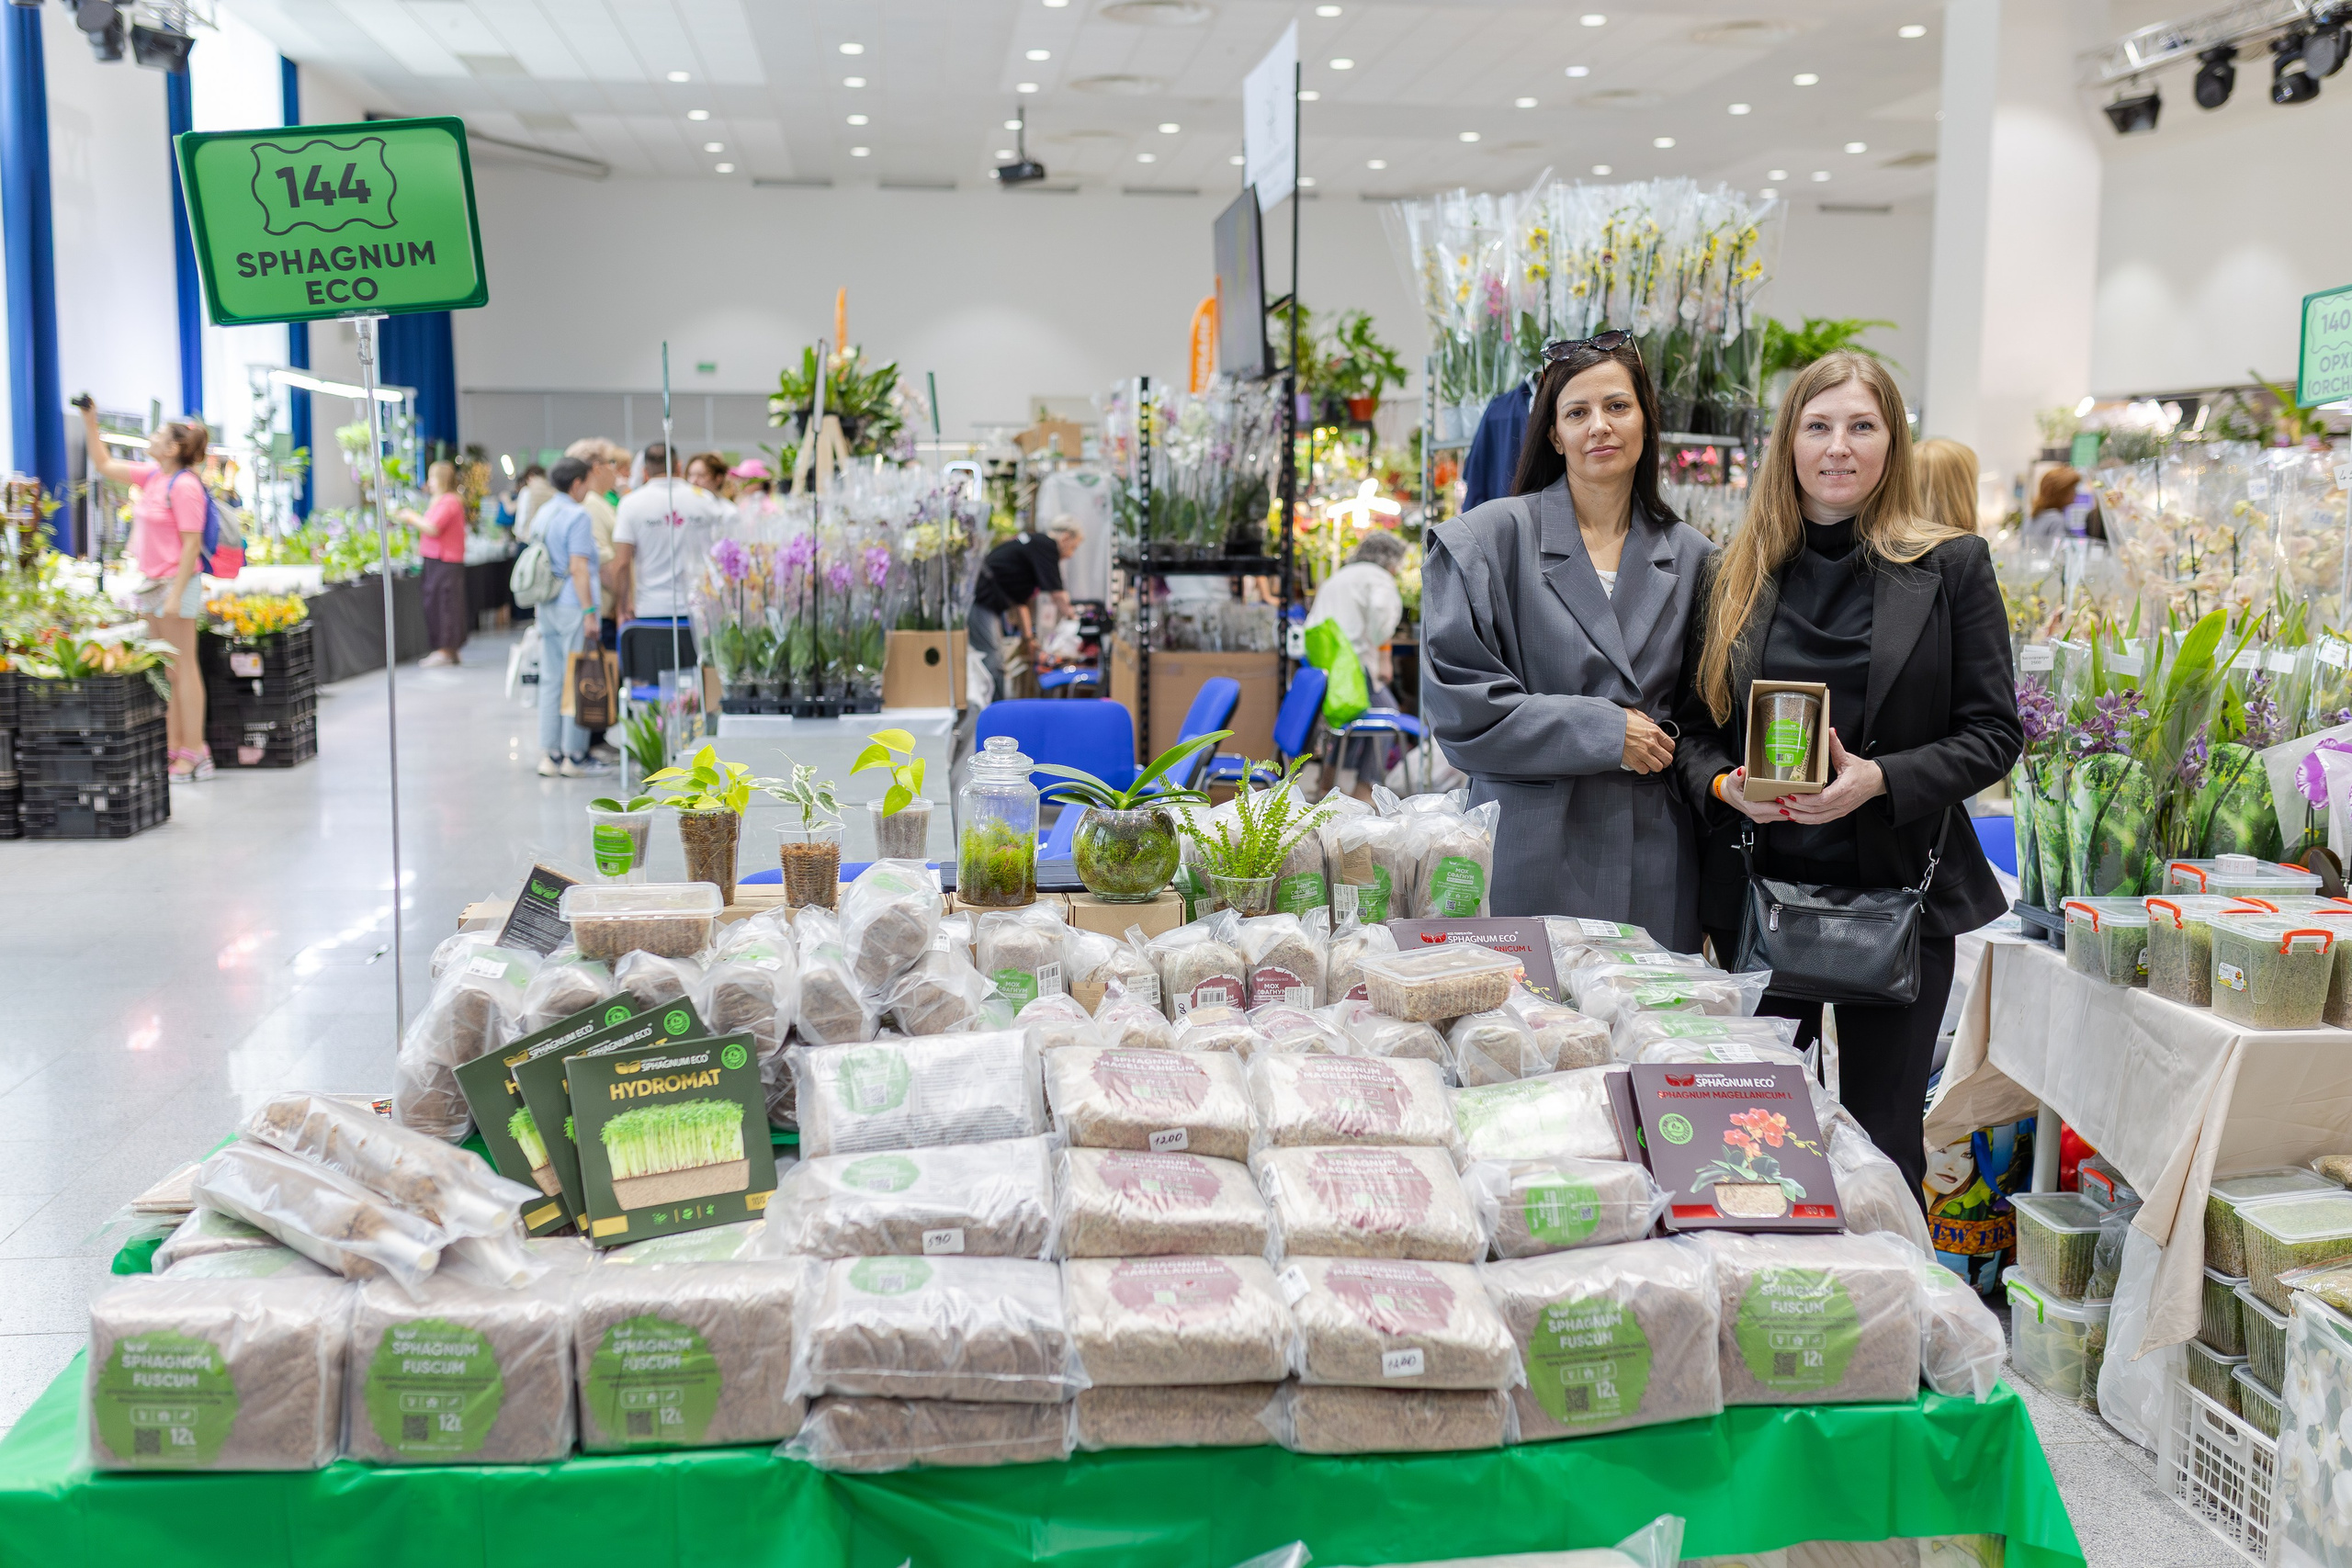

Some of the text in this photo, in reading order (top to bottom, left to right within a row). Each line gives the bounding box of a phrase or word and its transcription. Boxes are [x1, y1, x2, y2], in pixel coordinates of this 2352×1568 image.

[275, 163, 371, 209] 144
[236, 241, 436, 278] SPHAGNUM
[305, 276, 379, 305] ECO
[2322, 309, 2351, 334] 140
[2319, 352, 2352, 373] ОРХ
[2307, 374, 2352, 399] (ORCH
[1448, 934, 1517, 943] SPHAGNUM ECO
[528, 1024, 594, 1059] SPHAGNUM ECO
[633, 1027, 653, 1041] ECO
[640, 1054, 709, 1072] SPHAGNUM ECO
[1100, 1060, 1194, 1072] MAGELLANICUM
[1113, 1056, 1180, 1066] SPHAGNUM
[1303, 1071, 1396, 1083] MAGELLANICUM
[1316, 1065, 1381, 1075] SPHAGNUM
[609, 1068, 721, 1100] HYDROMAT
[1695, 1077, 1775, 1088] SPHAGNUM ECO
[1657, 1090, 1710, 1099] SPHAGNUM
[1713, 1091, 1786, 1100] MAGELLANICUM
[1804, 1206, 1818, 1215] 100
[1760, 1284, 1834, 1298] SPHAGNUM
[1770, 1301, 1826, 1314] FUSCUM
[1548, 1313, 1623, 1334] SPHAGNUM
[612, 1337, 693, 1354] SPHAGNUM
[1559, 1330, 1613, 1348] FUSCUM
[391, 1342, 479, 1357] SPHAGNUM
[121, 1354, 212, 1370] SPHAGNUM
[402, 1359, 467, 1374] FUSCUM
[622, 1355, 682, 1371] FUSCUM
[133, 1373, 198, 1387] FUSCUM
[1595, 1379, 1619, 1398] 12L
[438, 1413, 464, 1432] 12L
[659, 1407, 684, 1425] 12L
[170, 1427, 197, 1445] 12L
